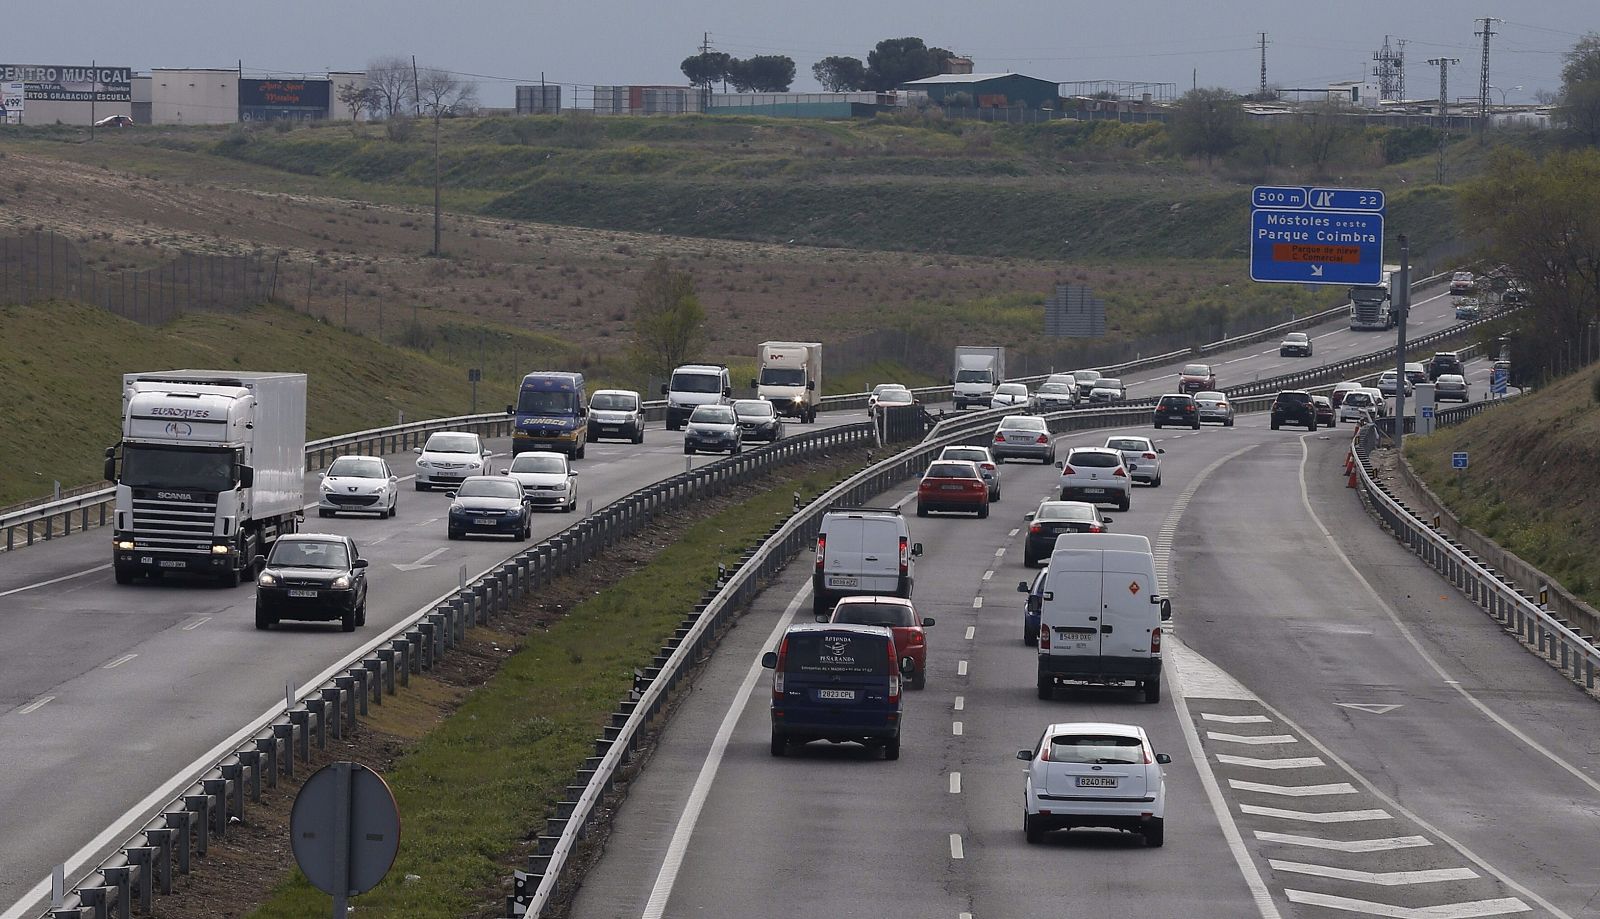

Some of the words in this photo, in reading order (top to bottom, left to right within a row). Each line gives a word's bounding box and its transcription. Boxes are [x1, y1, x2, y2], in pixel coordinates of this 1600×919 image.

[62, 69, 131, 83] MUSICAL
[97, 93, 131, 101] ESCUELA
[1259, 192, 1285, 202] 500
[1290, 195, 1300, 203] m
[1359, 196, 1377, 205] 22
[1267, 214, 1330, 227] Móstoles
[1258, 228, 1309, 242] Parque
[1317, 231, 1376, 242] Coimbra
[1292, 245, 1321, 254] Parque
[1302, 253, 1343, 262] Comercial
[151, 407, 210, 418] EUROAVES
[522, 418, 567, 426] SUNOCO
[158, 491, 192, 500] SCANIA
[1081, 778, 1100, 786] 8240
[1101, 778, 1116, 786] FHM
